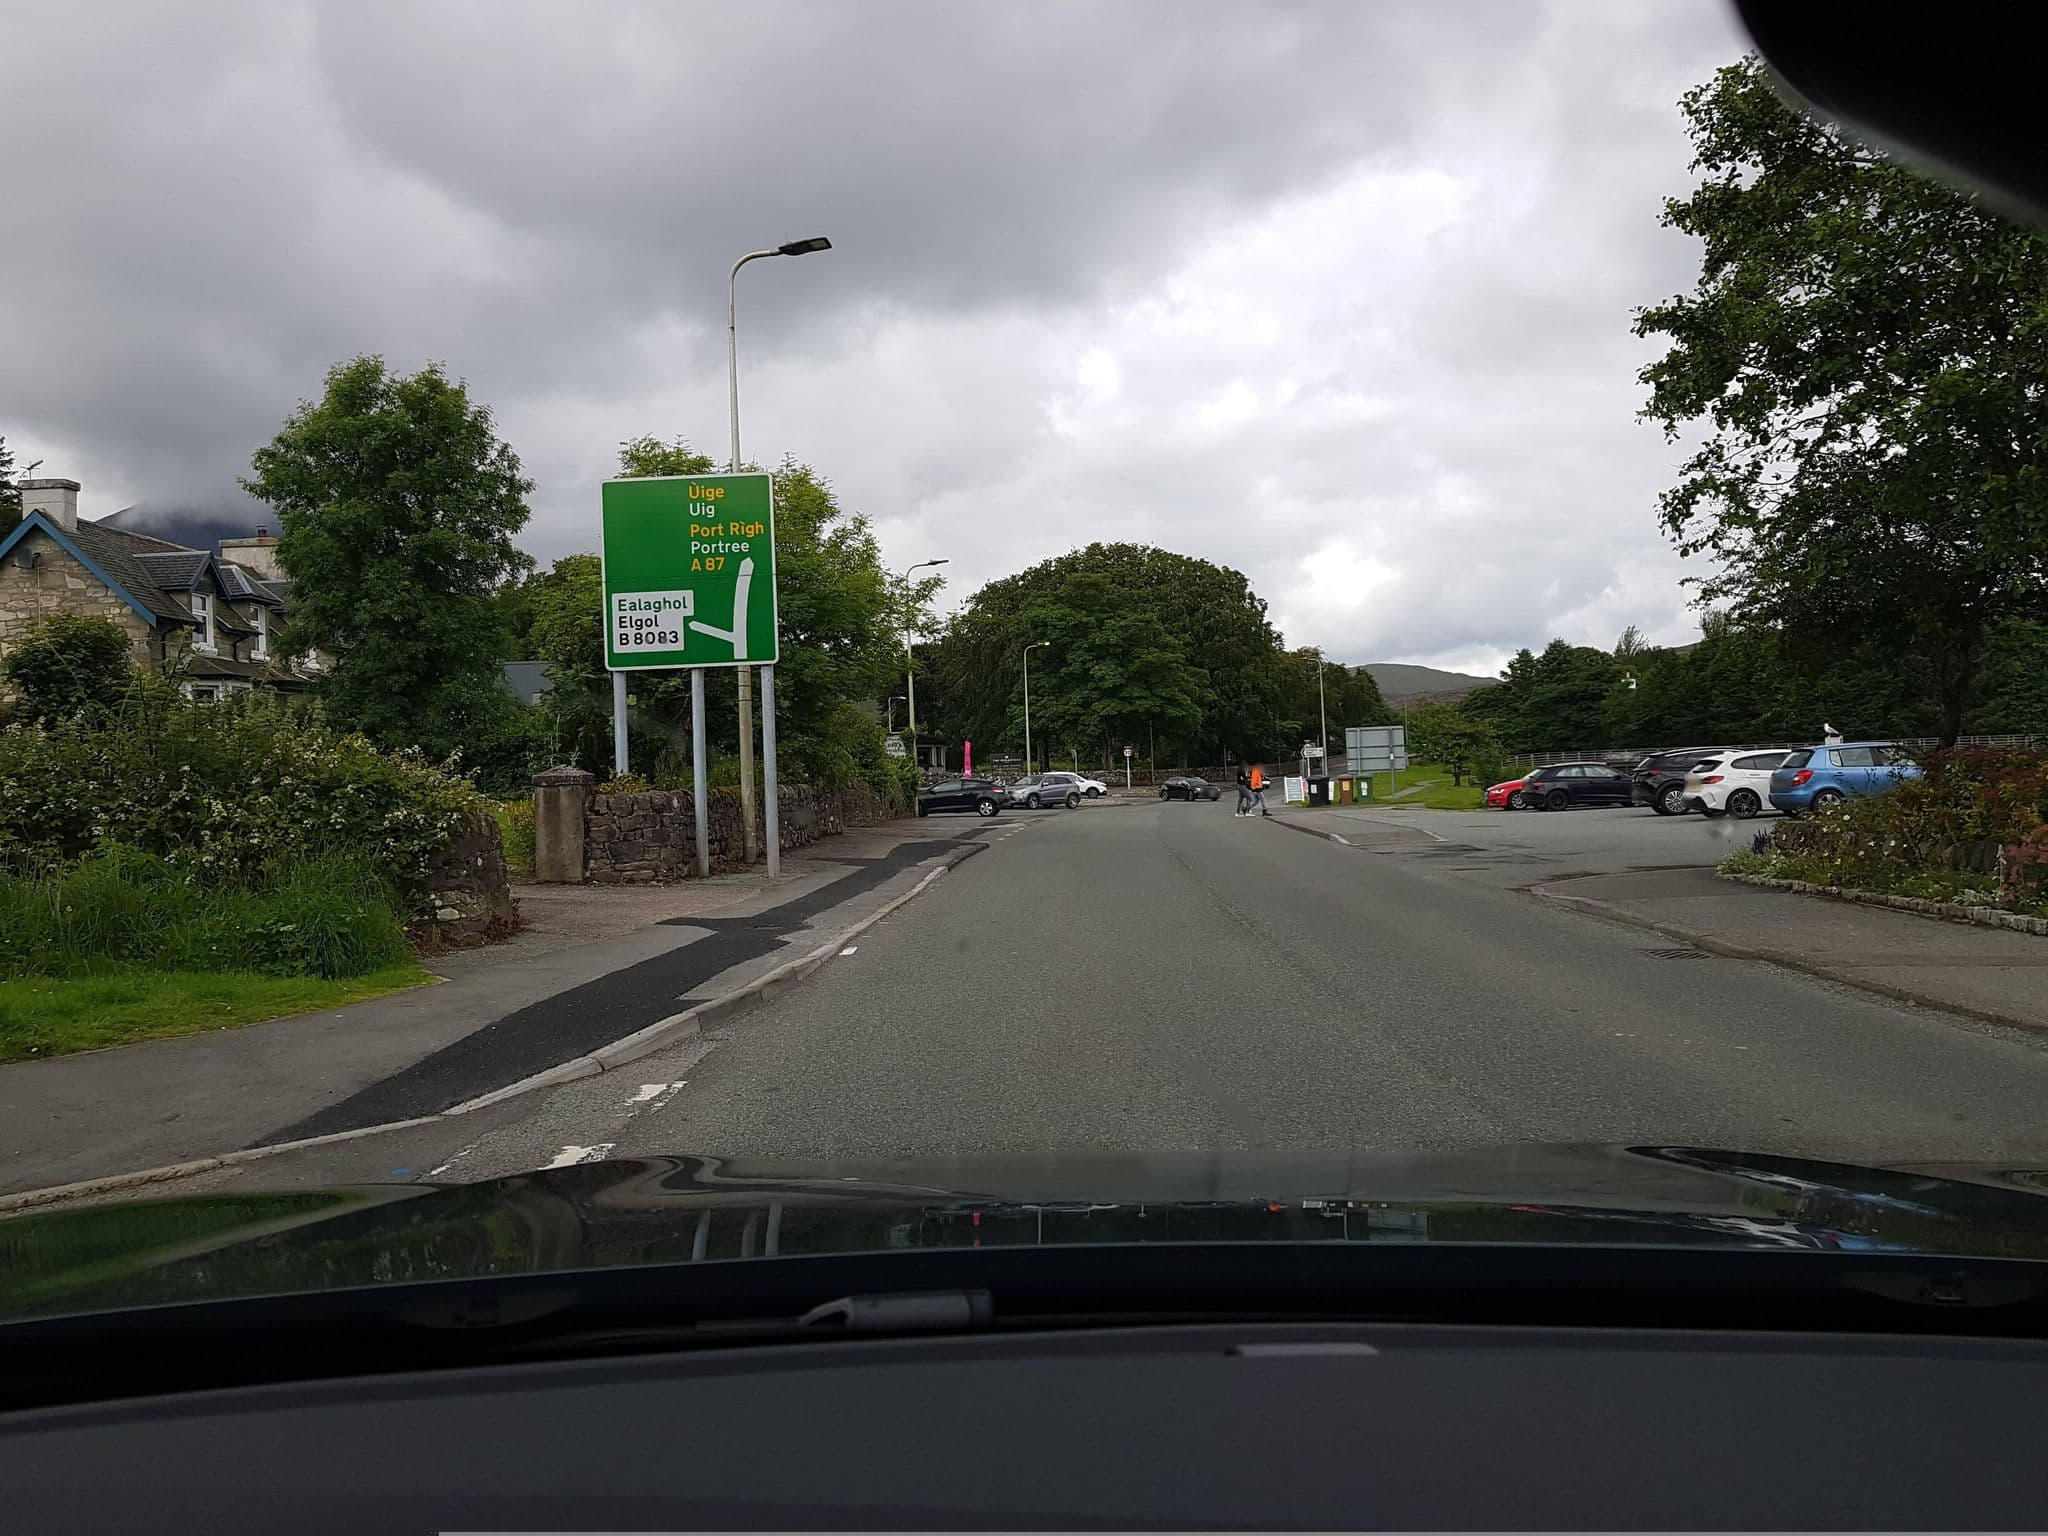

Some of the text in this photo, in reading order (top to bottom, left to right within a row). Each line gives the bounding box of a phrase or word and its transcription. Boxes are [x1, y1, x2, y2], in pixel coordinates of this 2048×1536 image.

[689, 502, 715, 518] Uig
[690, 523, 725, 538] Port
[690, 540, 750, 554] Portree
[618, 596, 688, 613] Ealaghol
[618, 614, 660, 631] Elgol
[633, 630, 679, 645] 8083
